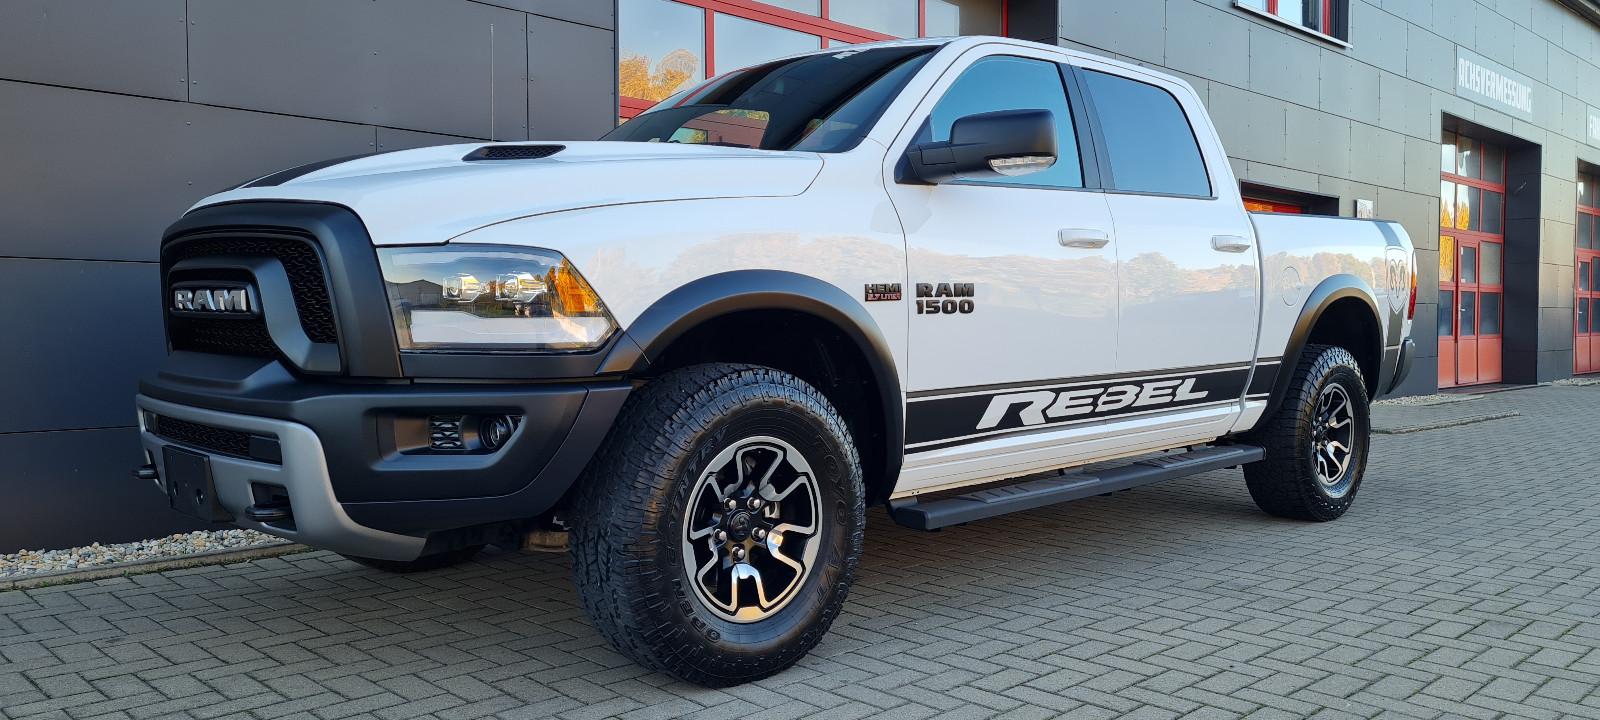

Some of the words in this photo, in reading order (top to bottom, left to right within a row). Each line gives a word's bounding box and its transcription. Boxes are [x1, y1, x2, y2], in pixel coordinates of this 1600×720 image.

[1458, 58, 1532, 113] ACHSVERMESSUNG
[864, 283, 902, 293] HEMI
[915, 283, 975, 298] RAM
[174, 289, 247, 311] RAM
[915, 299, 975, 315] 1500
[975, 377, 1209, 430] REBEL
